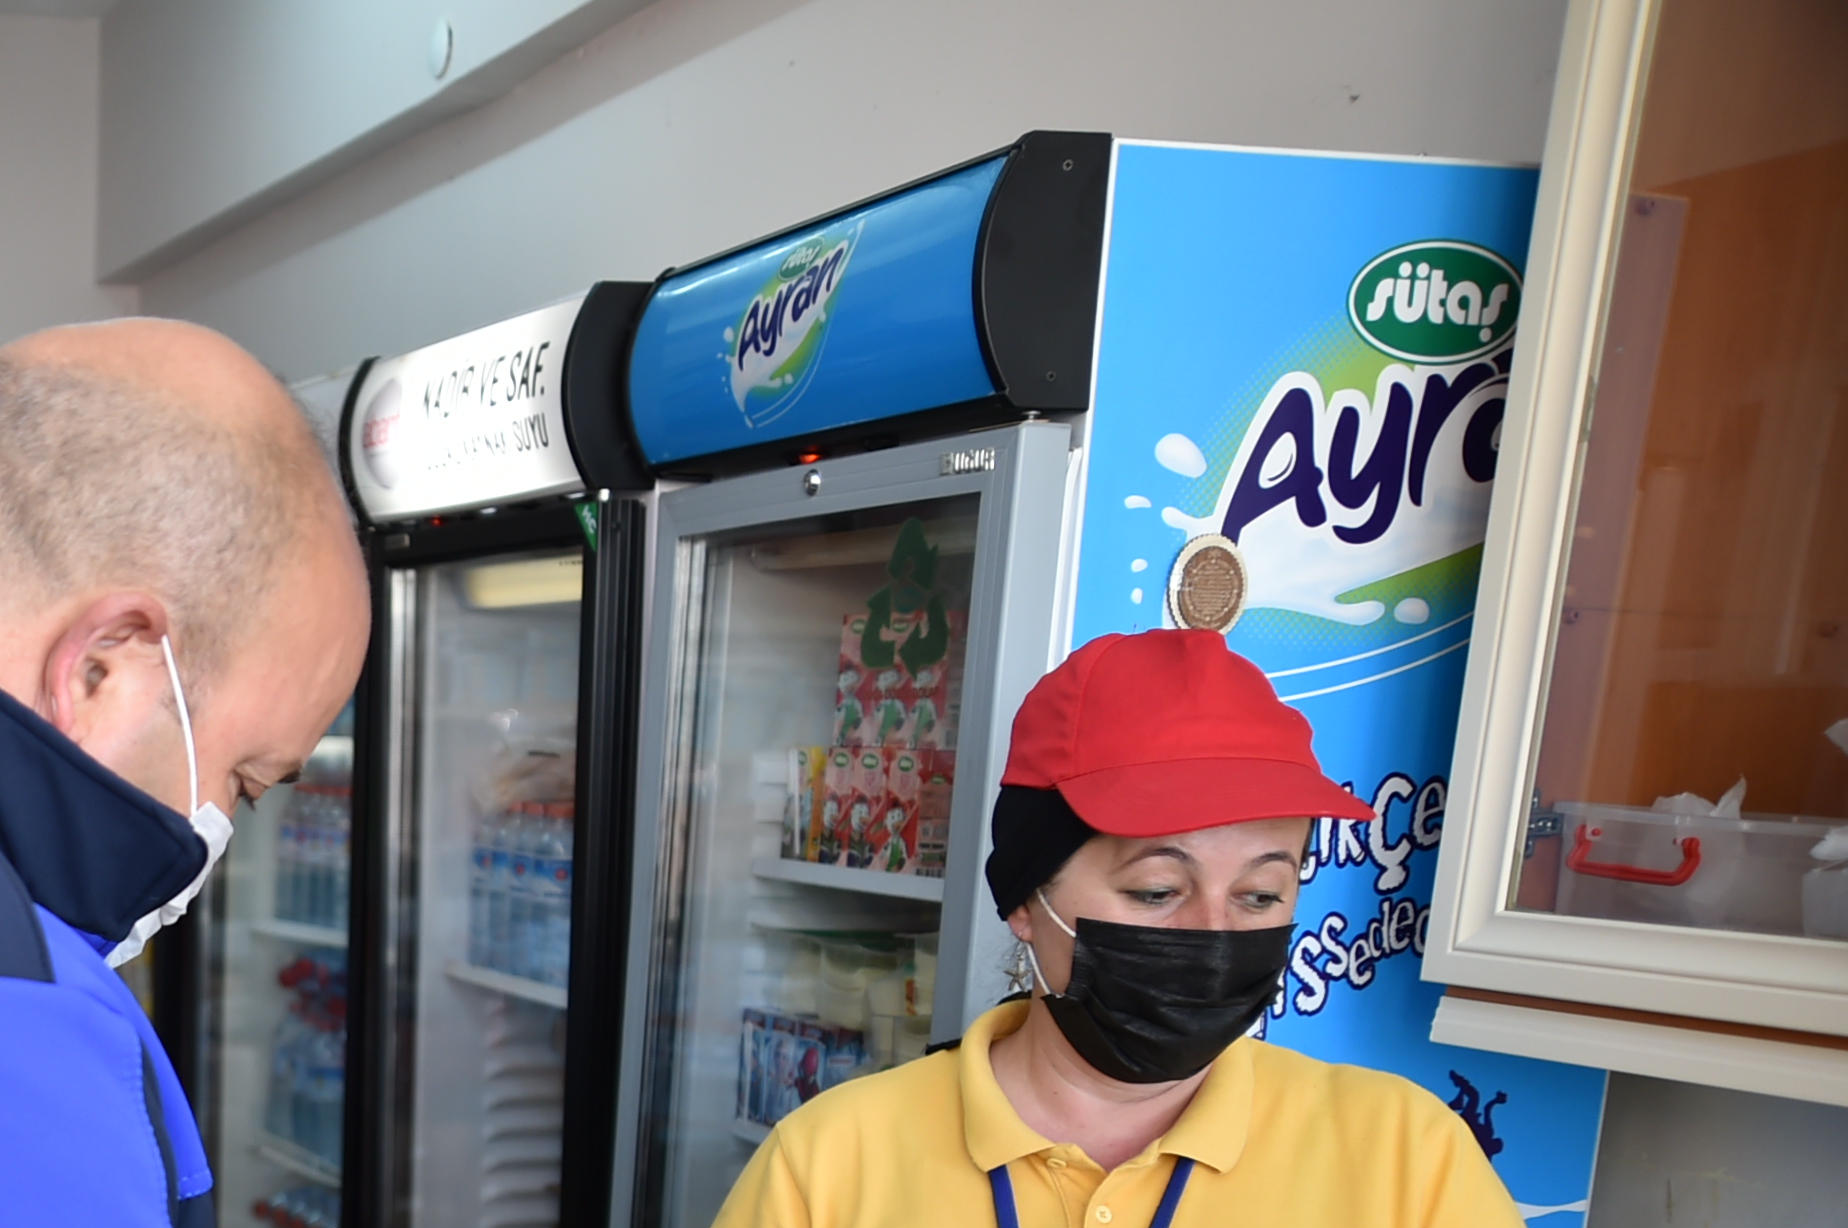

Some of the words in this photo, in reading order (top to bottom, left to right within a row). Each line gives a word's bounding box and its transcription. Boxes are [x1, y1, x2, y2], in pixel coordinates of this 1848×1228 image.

[737, 246, 845, 372] Ayran
[1365, 260, 1510, 343] sütaş
[506, 340, 552, 403] SAF.
[511, 411, 550, 453] SUYU
